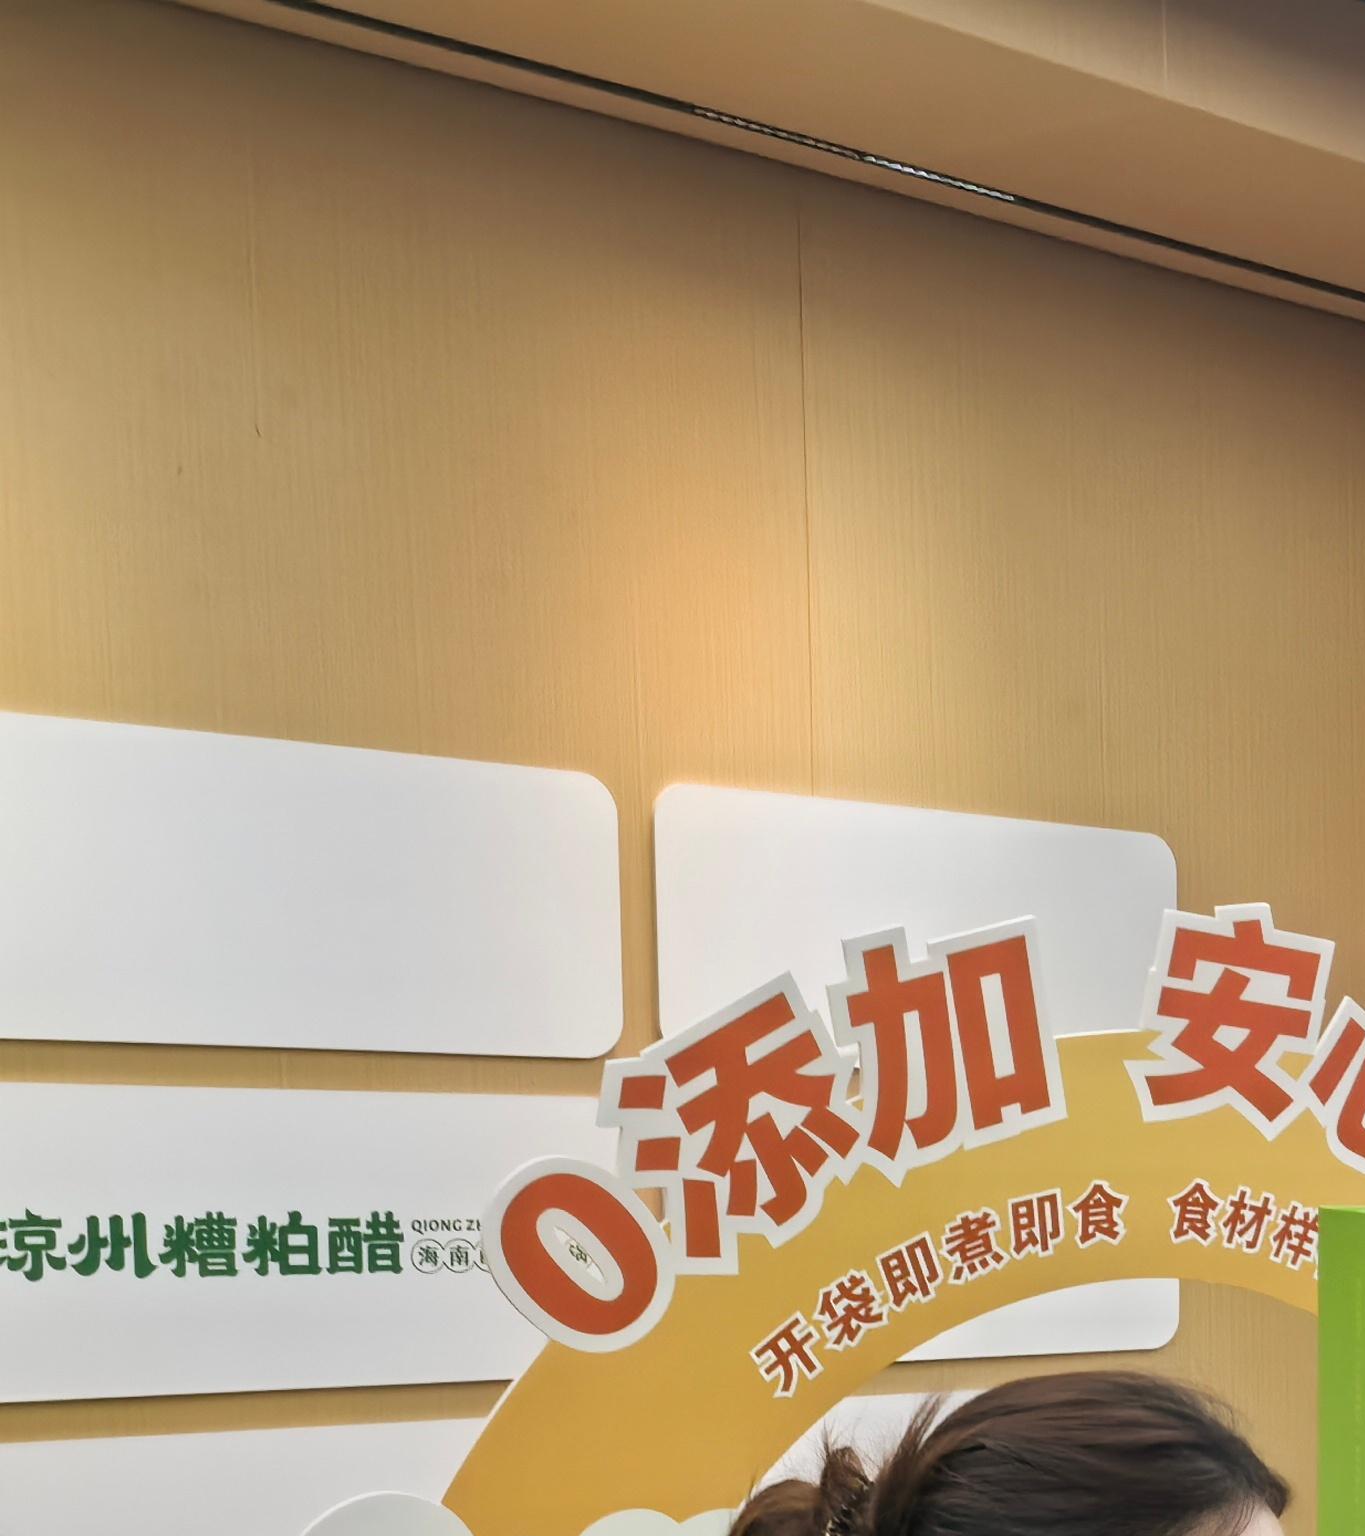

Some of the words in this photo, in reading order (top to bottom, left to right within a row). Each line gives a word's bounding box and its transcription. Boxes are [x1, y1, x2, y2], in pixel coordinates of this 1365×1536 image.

[411, 1217, 463, 1234] QIONG
[500, 934, 1052, 1336] 0添加
[754, 1182, 1126, 1394] 开袋即煮即食
